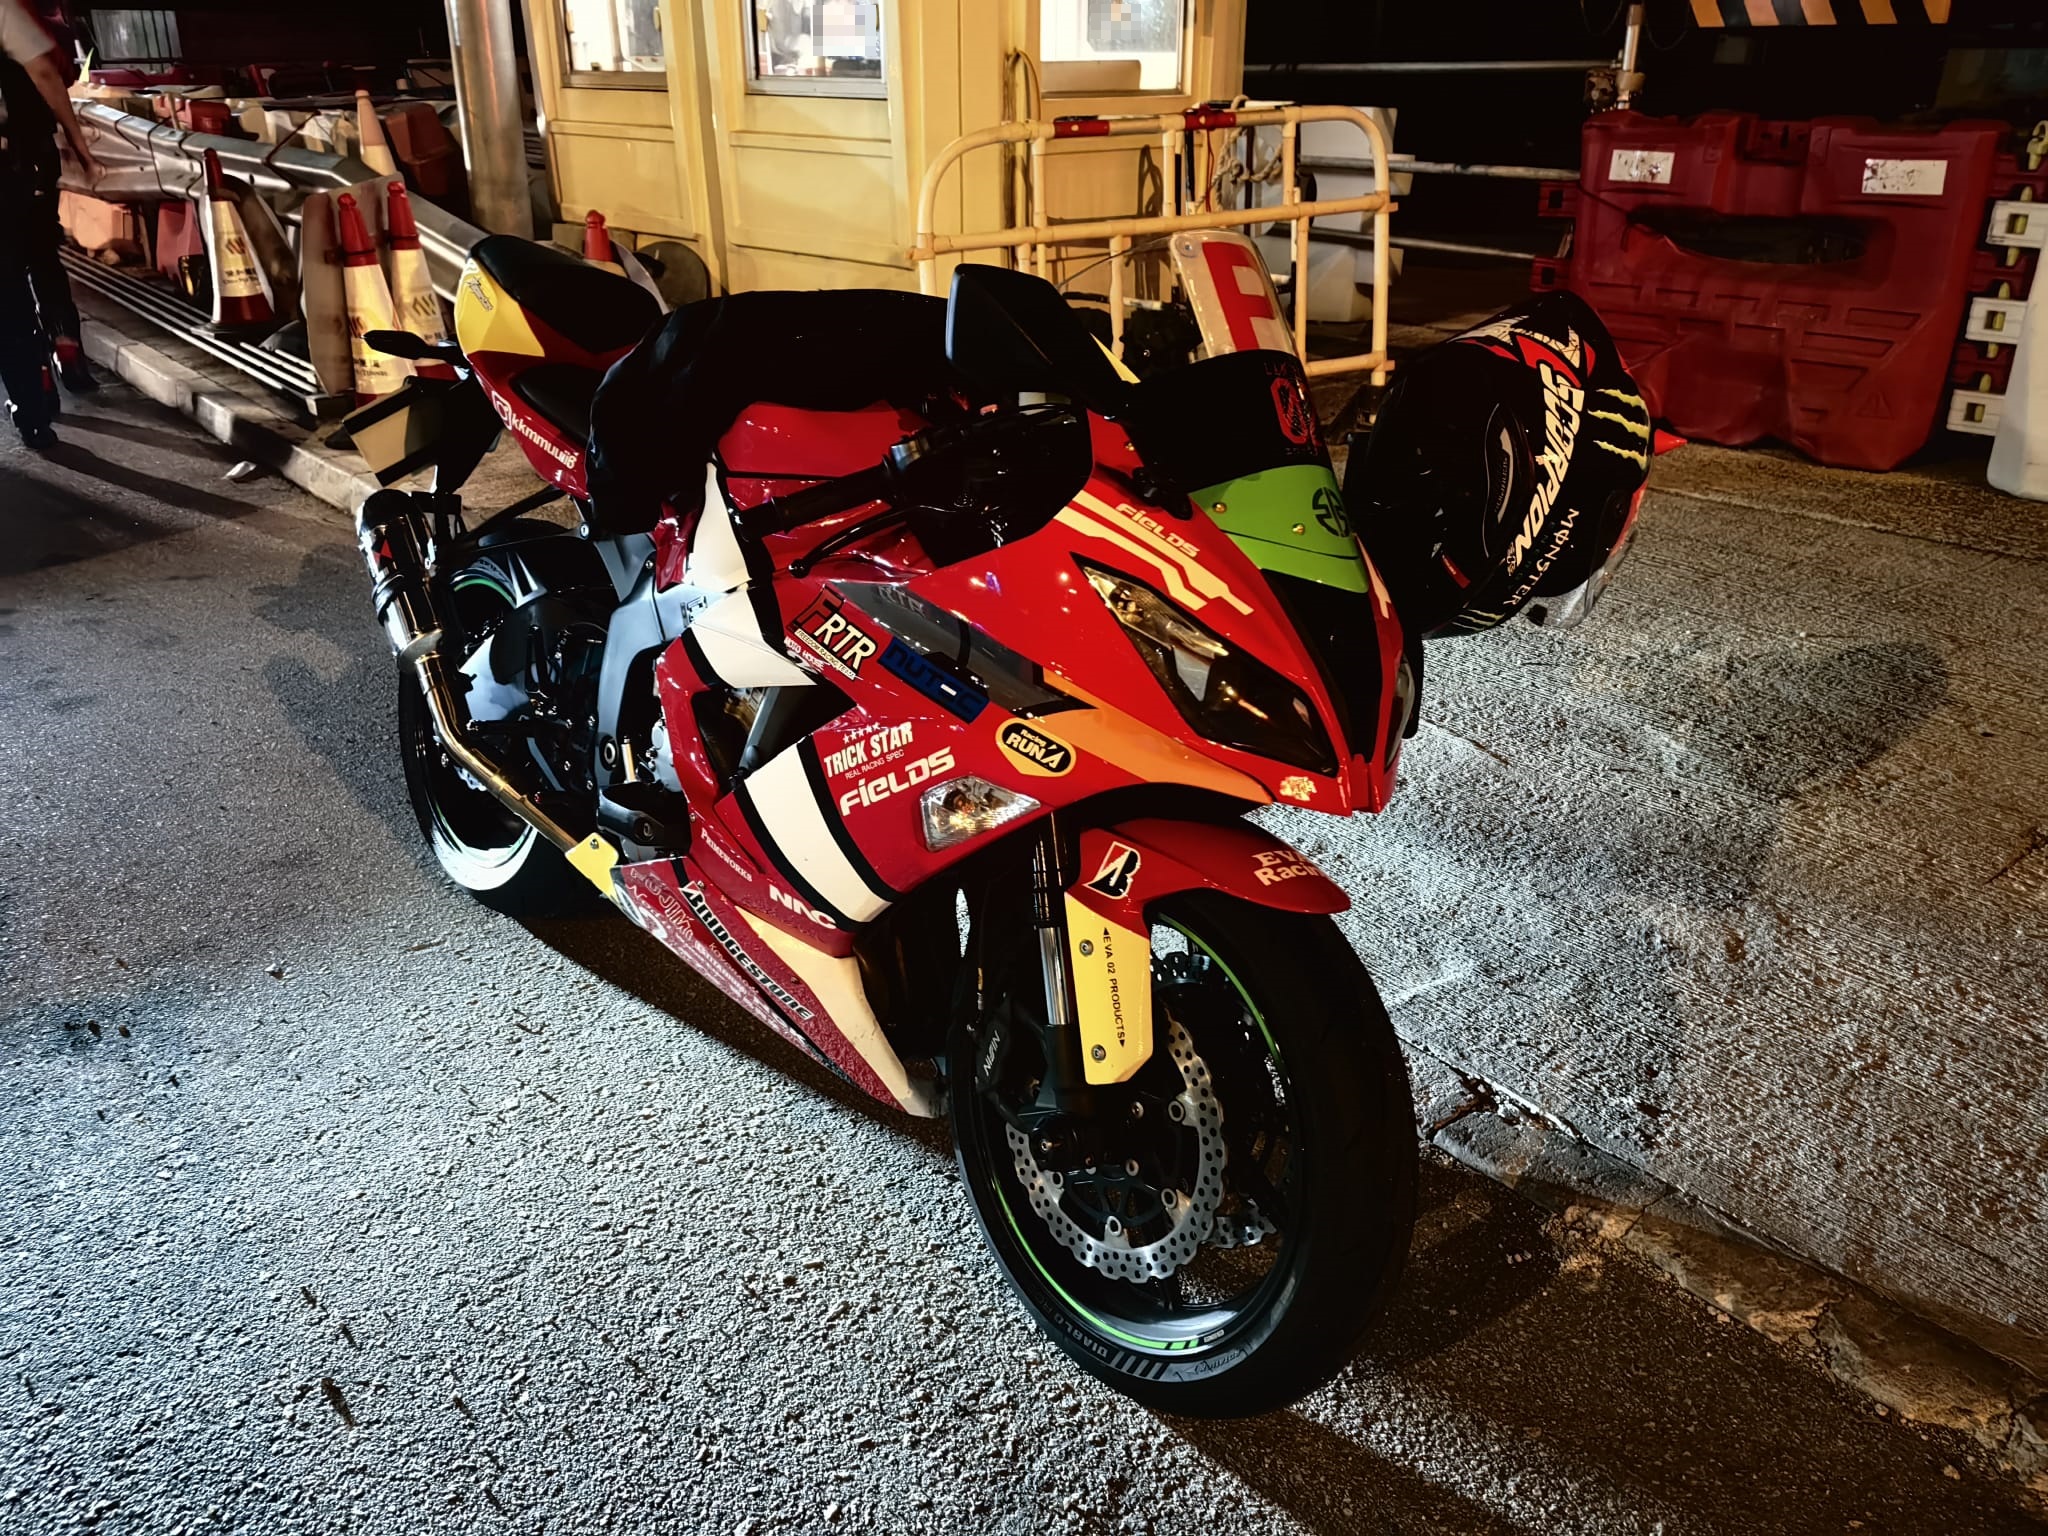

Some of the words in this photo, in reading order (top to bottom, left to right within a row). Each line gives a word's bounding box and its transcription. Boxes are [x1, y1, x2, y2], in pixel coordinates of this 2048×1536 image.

[1514, 363, 1585, 567] SCORPION
[824, 741, 867, 777] TRICK
[870, 721, 913, 757] STAR
[1020, 728, 1048, 747] Racing
[845, 769, 861, 780] REAL
[861, 758, 885, 773] RACING
[885, 749, 905, 763] SPEC
[679, 881, 815, 1020] BRIDGESTONE
[1103, 935, 1113, 959] EVA
[1107, 962, 1116, 975] 02
[1109, 978, 1126, 1040] PRODUCTS
[1054, 1312, 1109, 1359] DIABLO
